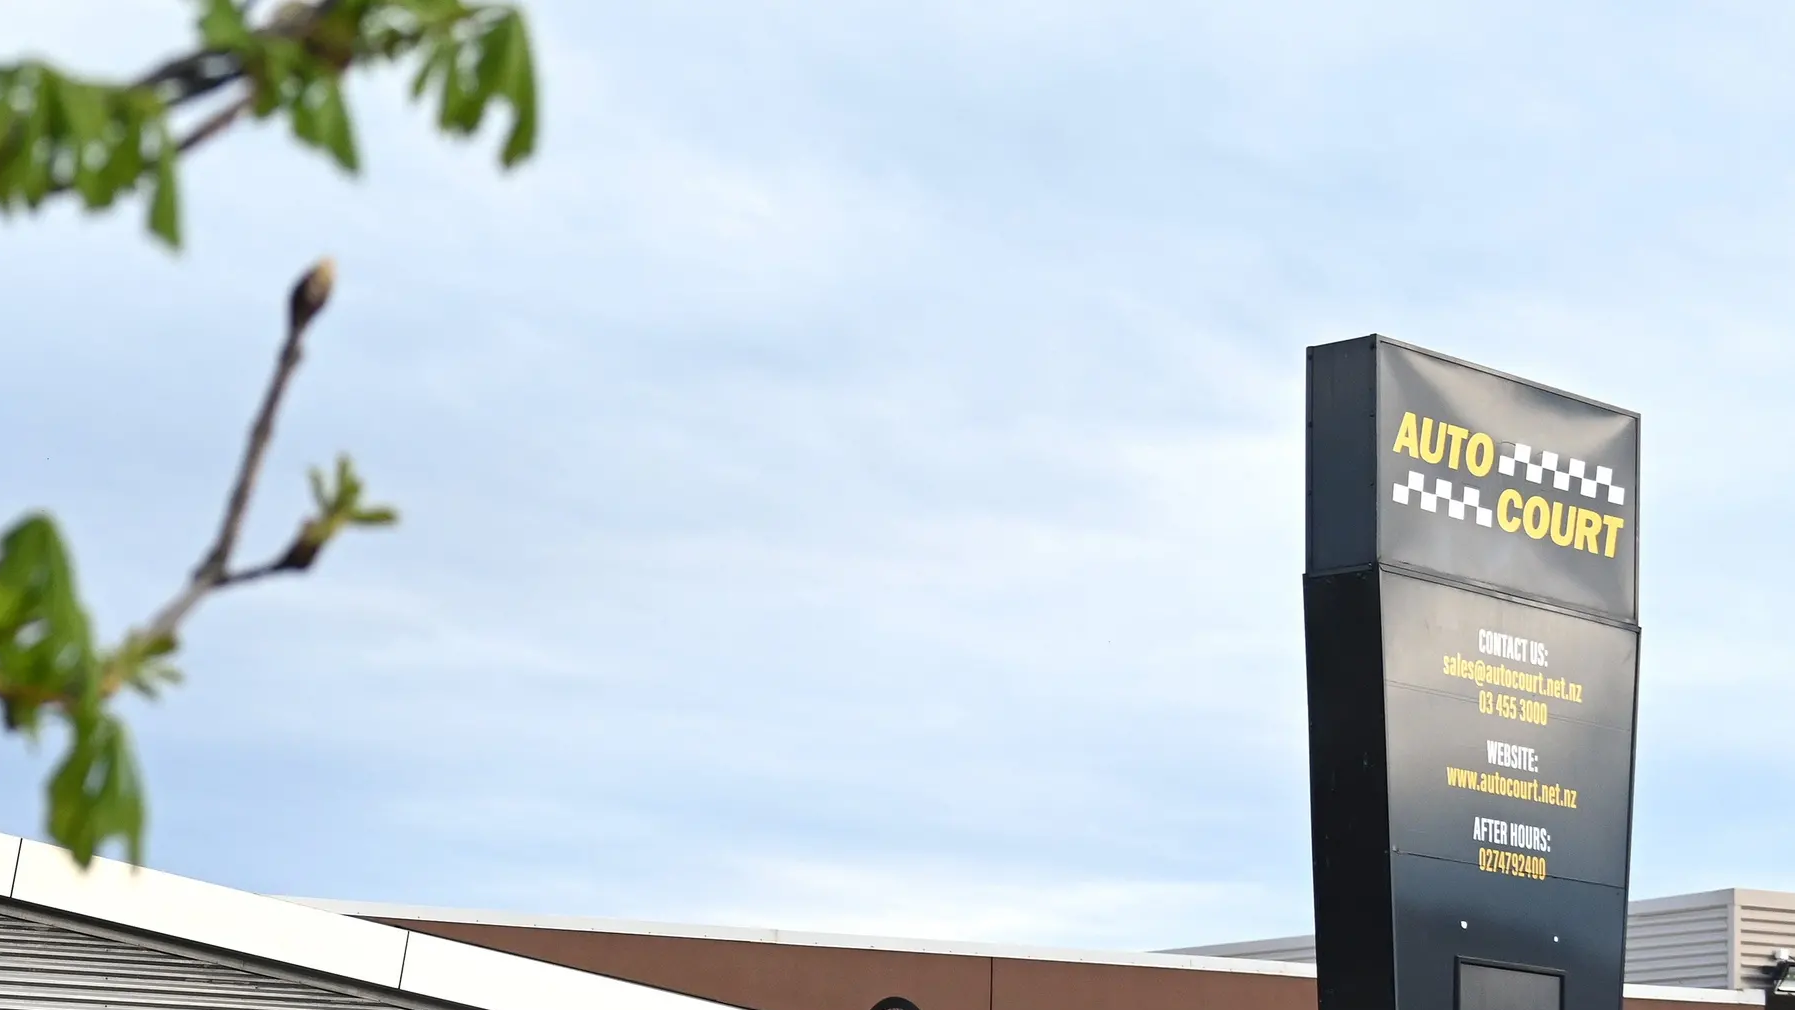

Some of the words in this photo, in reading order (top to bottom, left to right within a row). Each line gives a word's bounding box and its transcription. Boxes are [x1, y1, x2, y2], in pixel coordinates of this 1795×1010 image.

[1392, 411, 1495, 477] AUTO
[1497, 488, 1625, 558] COURT
[1478, 628, 1528, 662] CONTACT
[1529, 640, 1549, 667] US:
[1443, 652, 1583, 703] sales@autocourt.net.nz
[1478, 690, 1494, 714] 03
[1496, 693, 1517, 720] 455
[1519, 699, 1548, 726] 3000
[1486, 740, 1539, 773] WEBSITE:
[1446, 766, 1577, 809] www.autocourt.net.nz
[1473, 816, 1508, 845] AFTER
[1510, 822, 1551, 852] HOURS:
[1478, 847, 1546, 881] 0274792400
